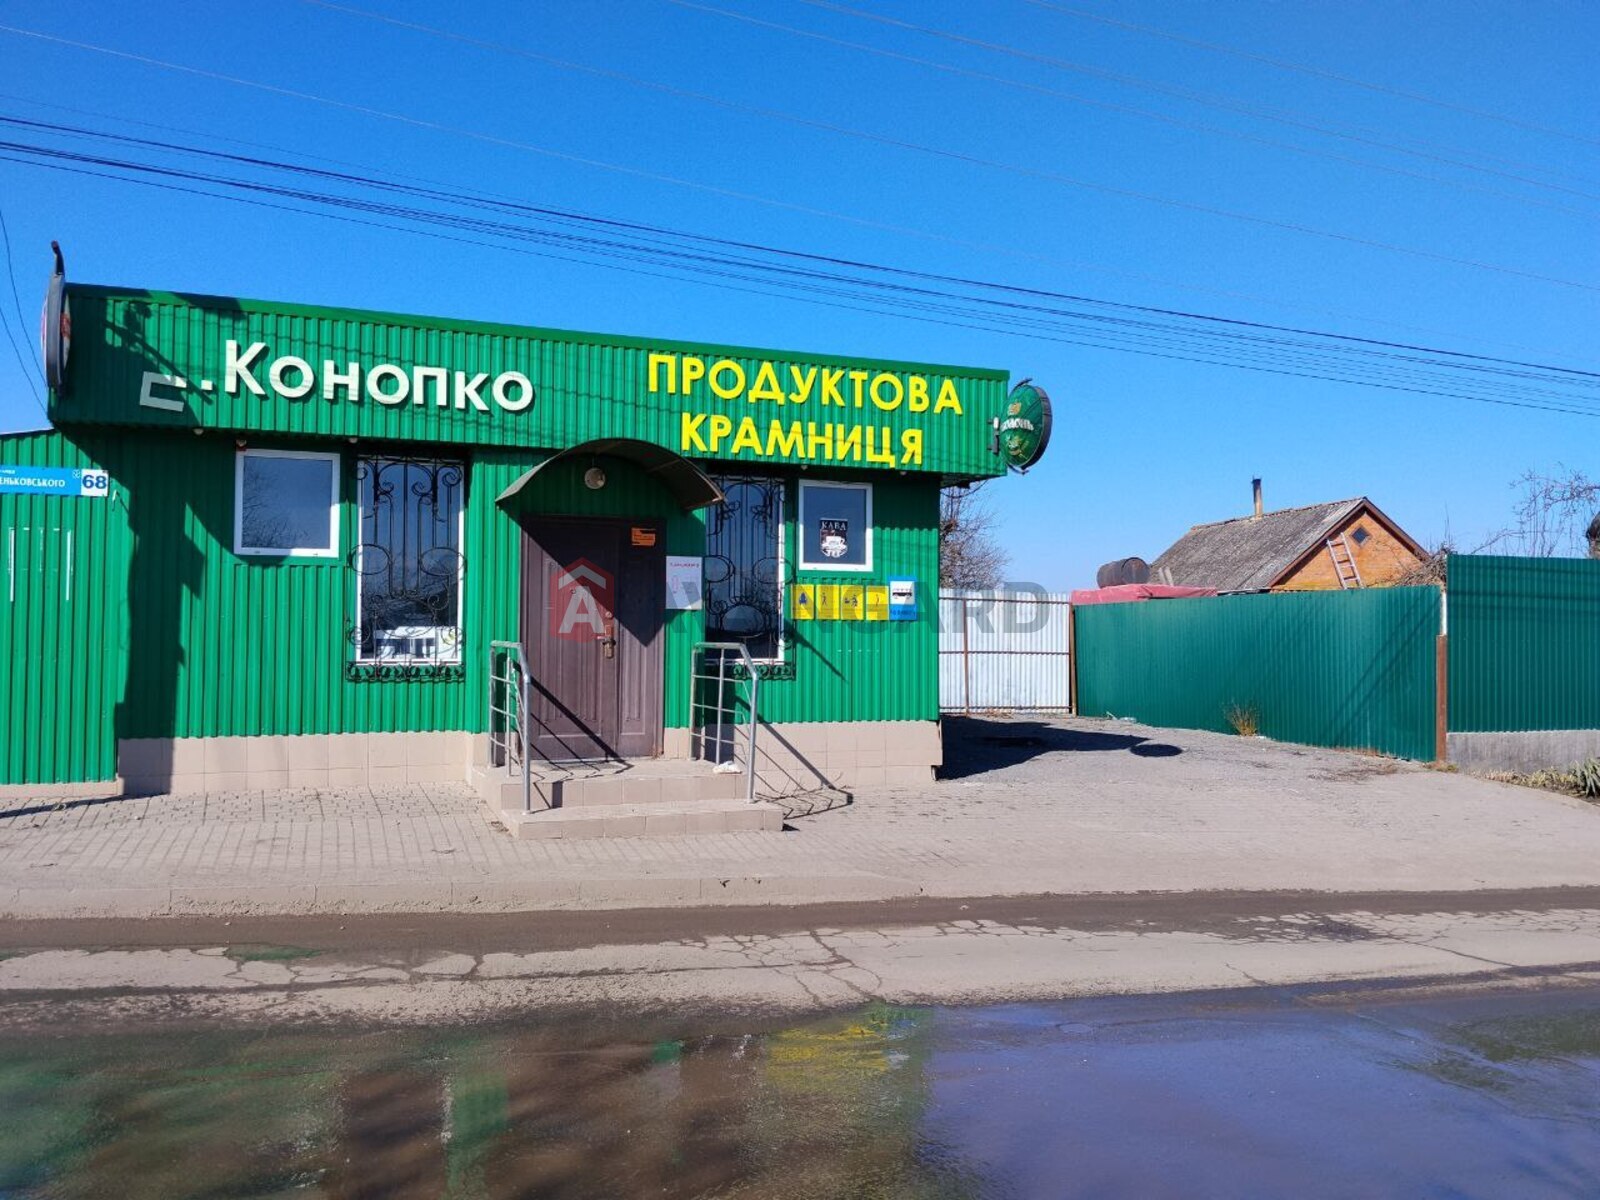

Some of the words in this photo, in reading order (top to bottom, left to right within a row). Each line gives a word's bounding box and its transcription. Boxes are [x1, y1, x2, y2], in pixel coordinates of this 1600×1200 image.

[648, 354, 963, 415] ПРОДУКТОВА
[681, 412, 923, 468] КРАМНИЦЯ
[82, 474, 107, 489] 68
[821, 521, 847, 531] КАВА
